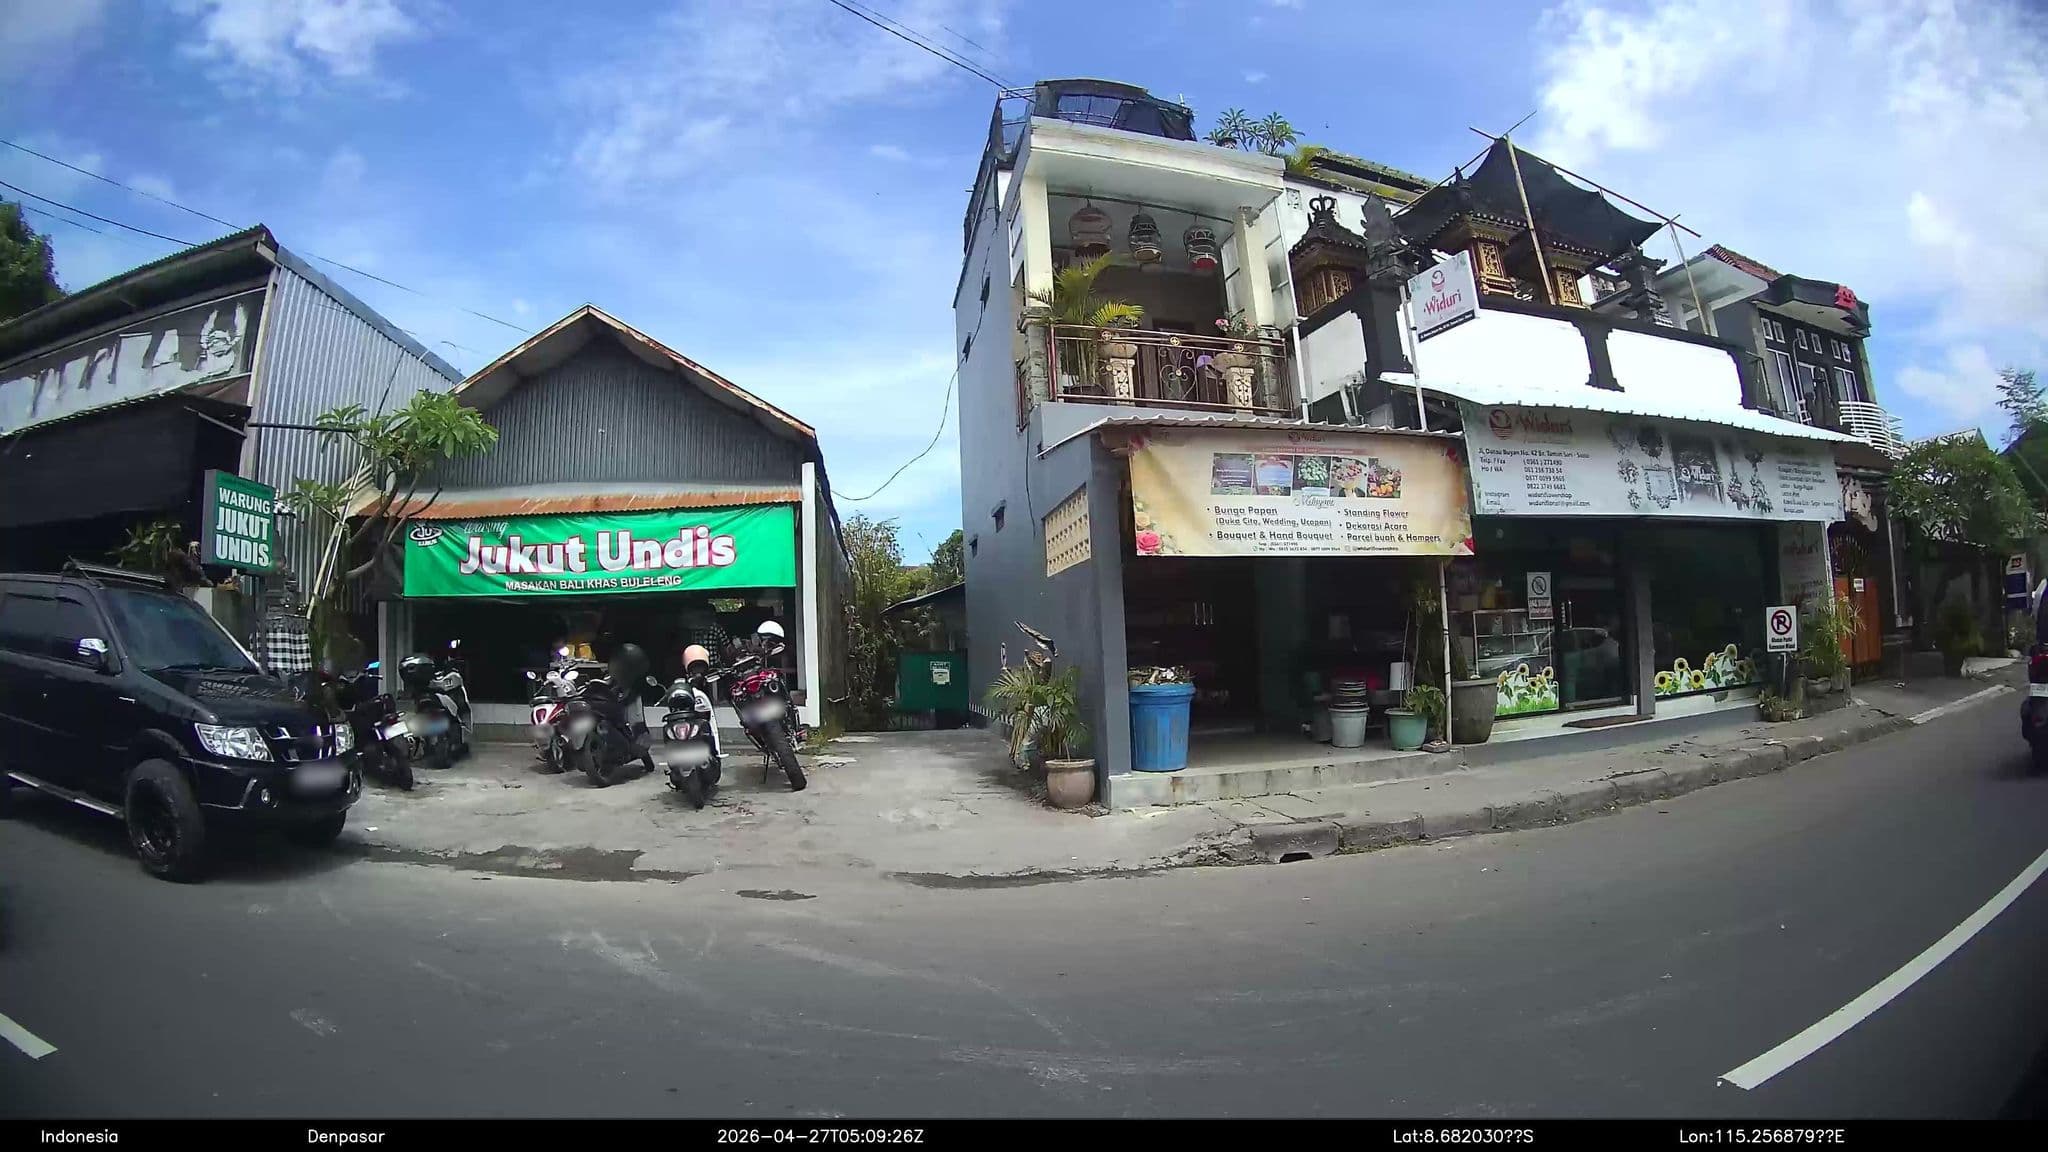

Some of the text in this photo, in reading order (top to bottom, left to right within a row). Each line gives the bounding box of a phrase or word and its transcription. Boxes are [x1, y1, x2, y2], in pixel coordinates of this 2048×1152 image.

[1424, 289, 1462, 315] Widuri
[219, 487, 271, 514] WARUNG
[1214, 506, 1278, 517] Bunga Papan
[1344, 508, 1409, 519] Standing Flower
[216, 506, 270, 540] JUKUT
[1262, 517, 1299, 528] Wedding,
[1300, 518, 1332, 528] Ucapan)
[1345, 521, 1408, 531] Dekorasi Acara
[1217, 530, 1333, 542] Bouquet & Hand Bouquet
[1346, 532, 1372, 541] Parcel
[1406, 533, 1441, 543] Hampers
[215, 533, 270, 567] UNDIS
[459, 525, 736, 576] Jukut Undis
[505, 576, 682, 591] MASAKAN BALI KHAS BULELENG
